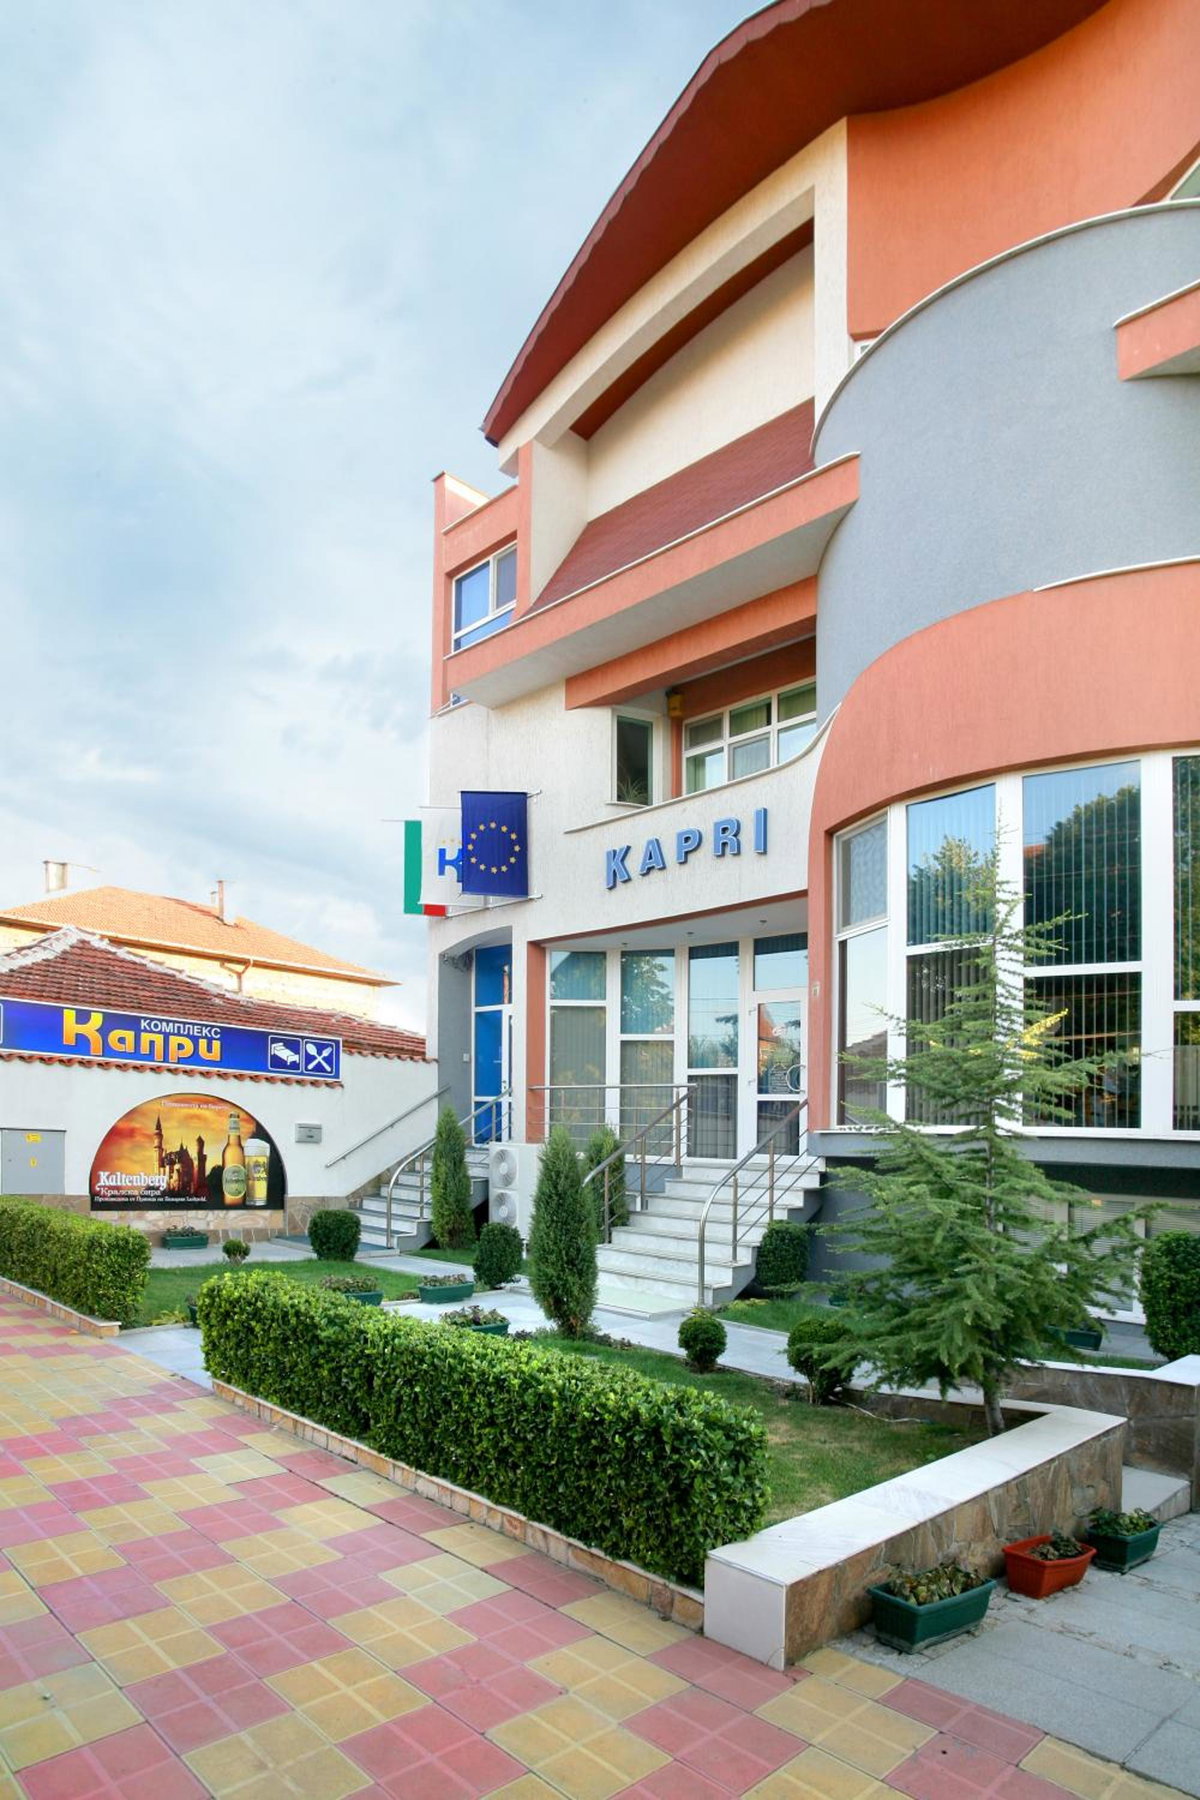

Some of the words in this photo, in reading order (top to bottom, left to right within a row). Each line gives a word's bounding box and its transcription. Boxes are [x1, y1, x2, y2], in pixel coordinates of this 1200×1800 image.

[605, 807, 768, 890] KAPRI
[62, 1008, 221, 1063] Капри
[140, 1019, 221, 1039] КОМПЛЕКС
[96, 1171, 168, 1191] Kaltenberg
